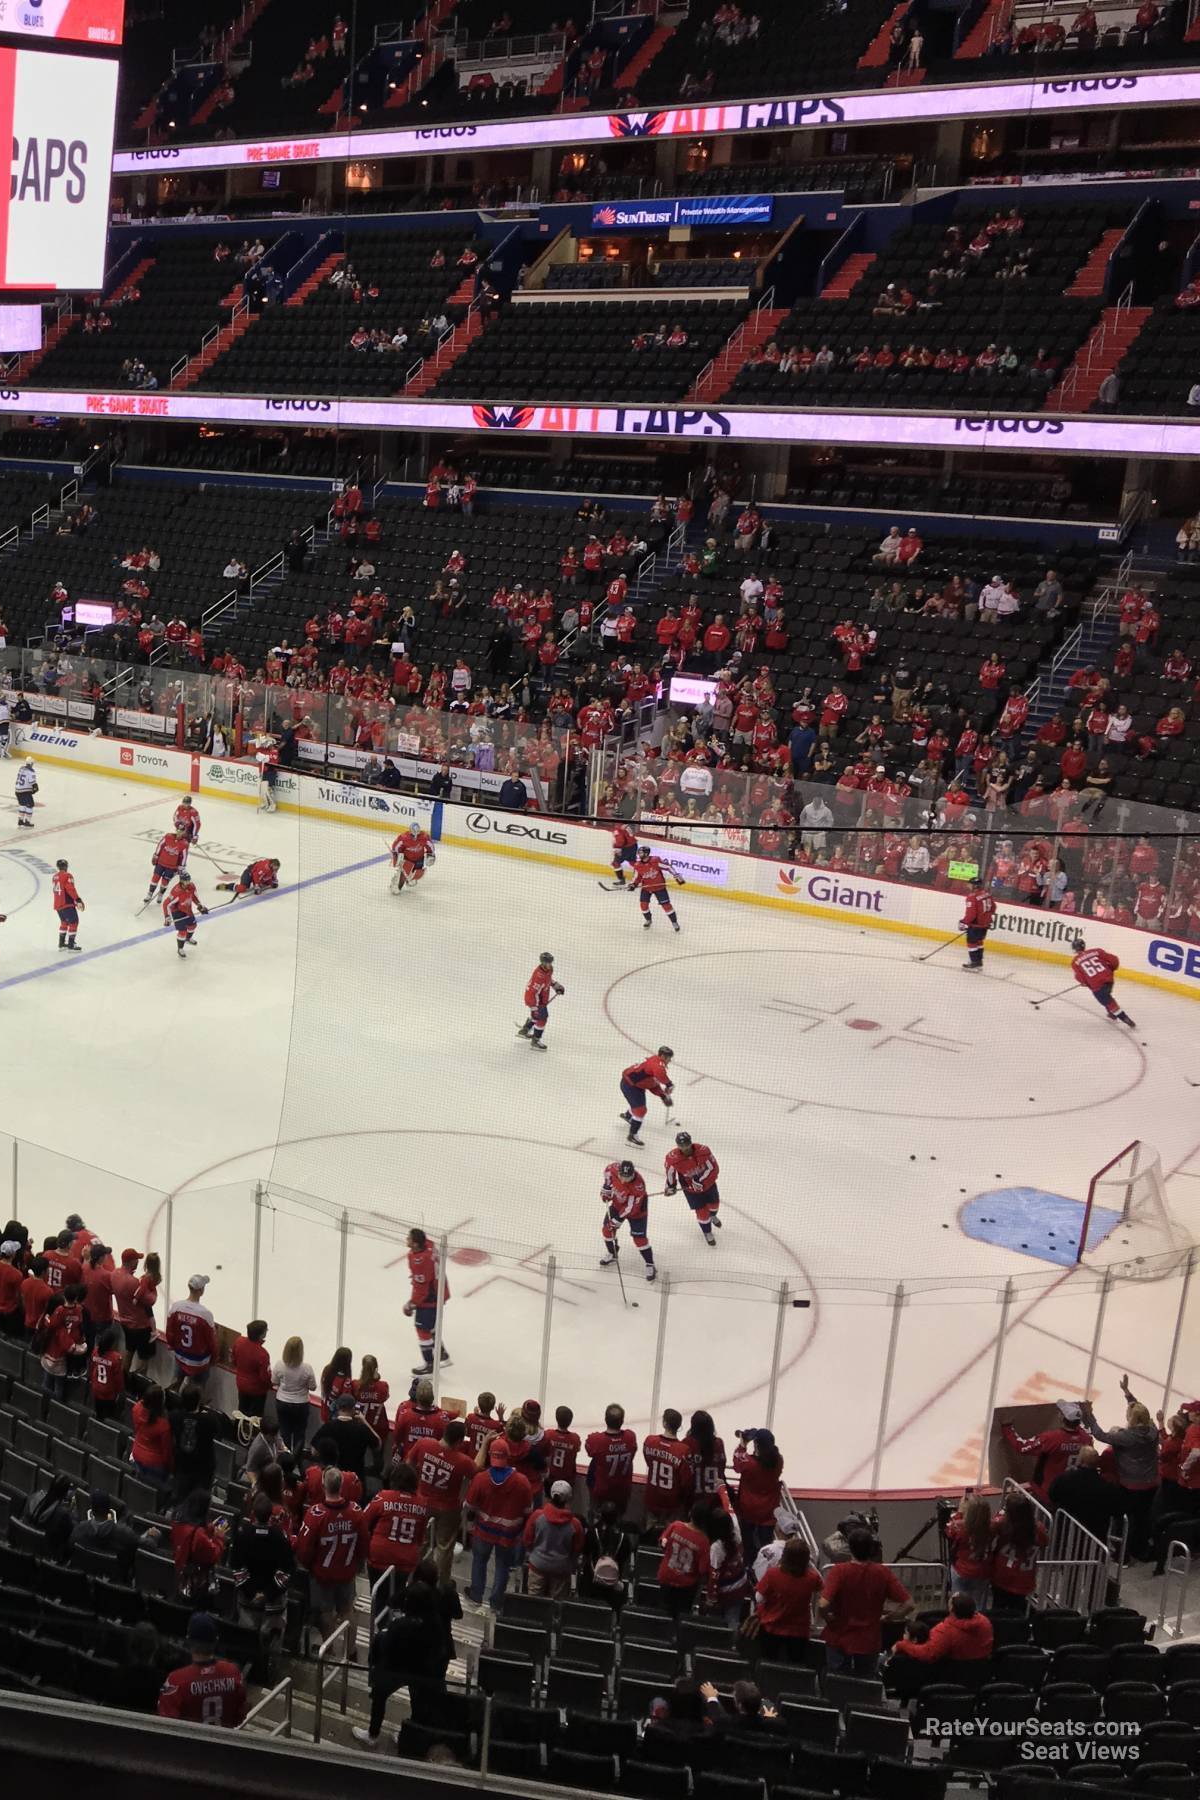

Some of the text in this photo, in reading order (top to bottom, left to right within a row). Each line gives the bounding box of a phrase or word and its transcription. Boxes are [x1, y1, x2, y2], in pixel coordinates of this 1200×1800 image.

[681, 205, 769, 216] Private Wealth Management
[30, 732, 78, 748] BOEING
[136, 754, 169, 768] TOYOTA
[225, 766, 236, 777] the
[236, 768, 259, 784] Gree
[273, 774, 297, 791] urtle
[392, 802, 416, 818] Son
[493, 818, 567, 846] LEXUS
[807, 875, 885, 913] Giant
[1081, 956, 1106, 978] 65
[180, 1324, 193, 1348] 3
[97, 1364, 107, 1385] 8
[552, 1449, 564, 1468] 8
[605, 1455, 630, 1477] 77
[420, 1464, 450, 1490] 92
[650, 1459, 674, 1490] 19
[383, 1499, 429, 1516] BACKSTROM
[328, 1519, 352, 1534] OSHIE
[389, 1516, 416, 1544] 19
[320, 1532, 358, 1568] 77
[190, 1676, 236, 1695] OVECHKIN
